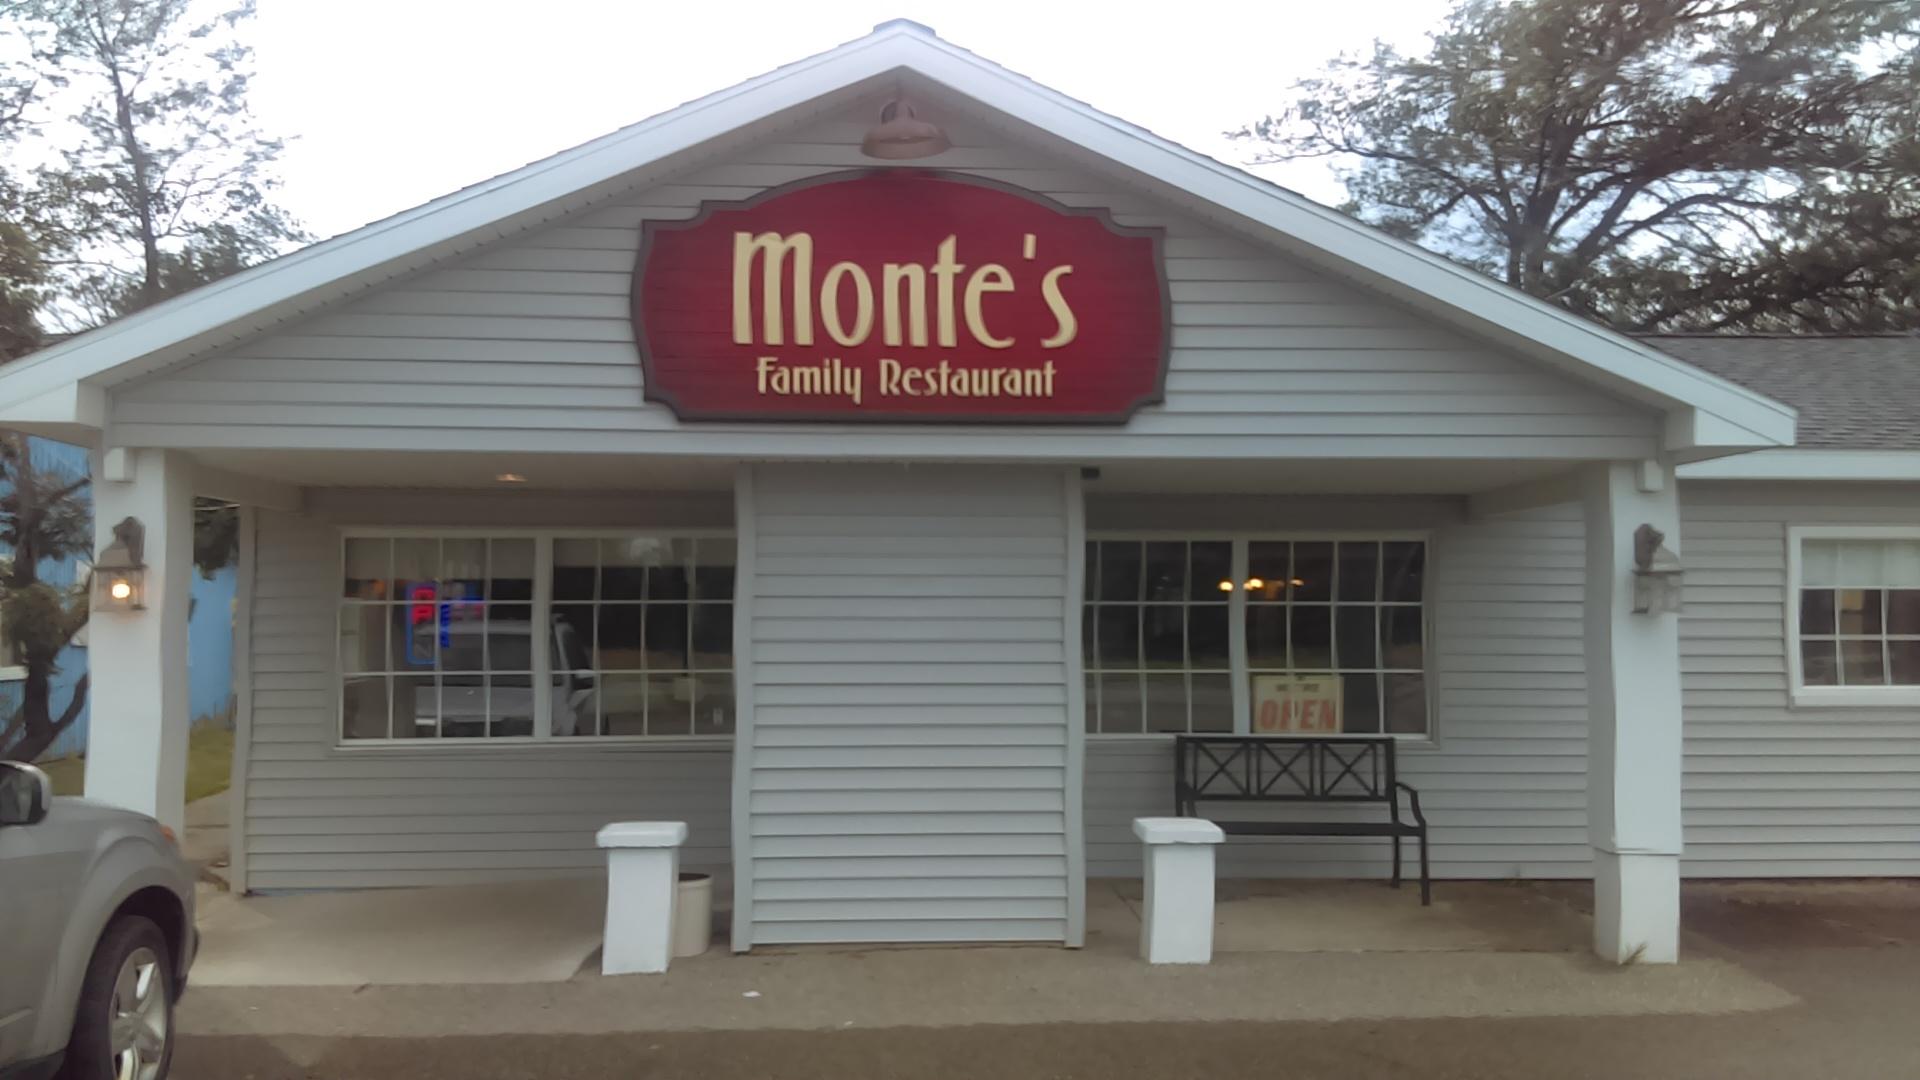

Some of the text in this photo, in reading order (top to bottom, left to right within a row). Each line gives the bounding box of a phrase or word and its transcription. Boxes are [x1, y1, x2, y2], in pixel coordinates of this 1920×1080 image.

[732, 231, 1078, 348] Monte's
[756, 357, 1056, 404] Family Restaurant
[1259, 698, 1338, 731] OPEN
